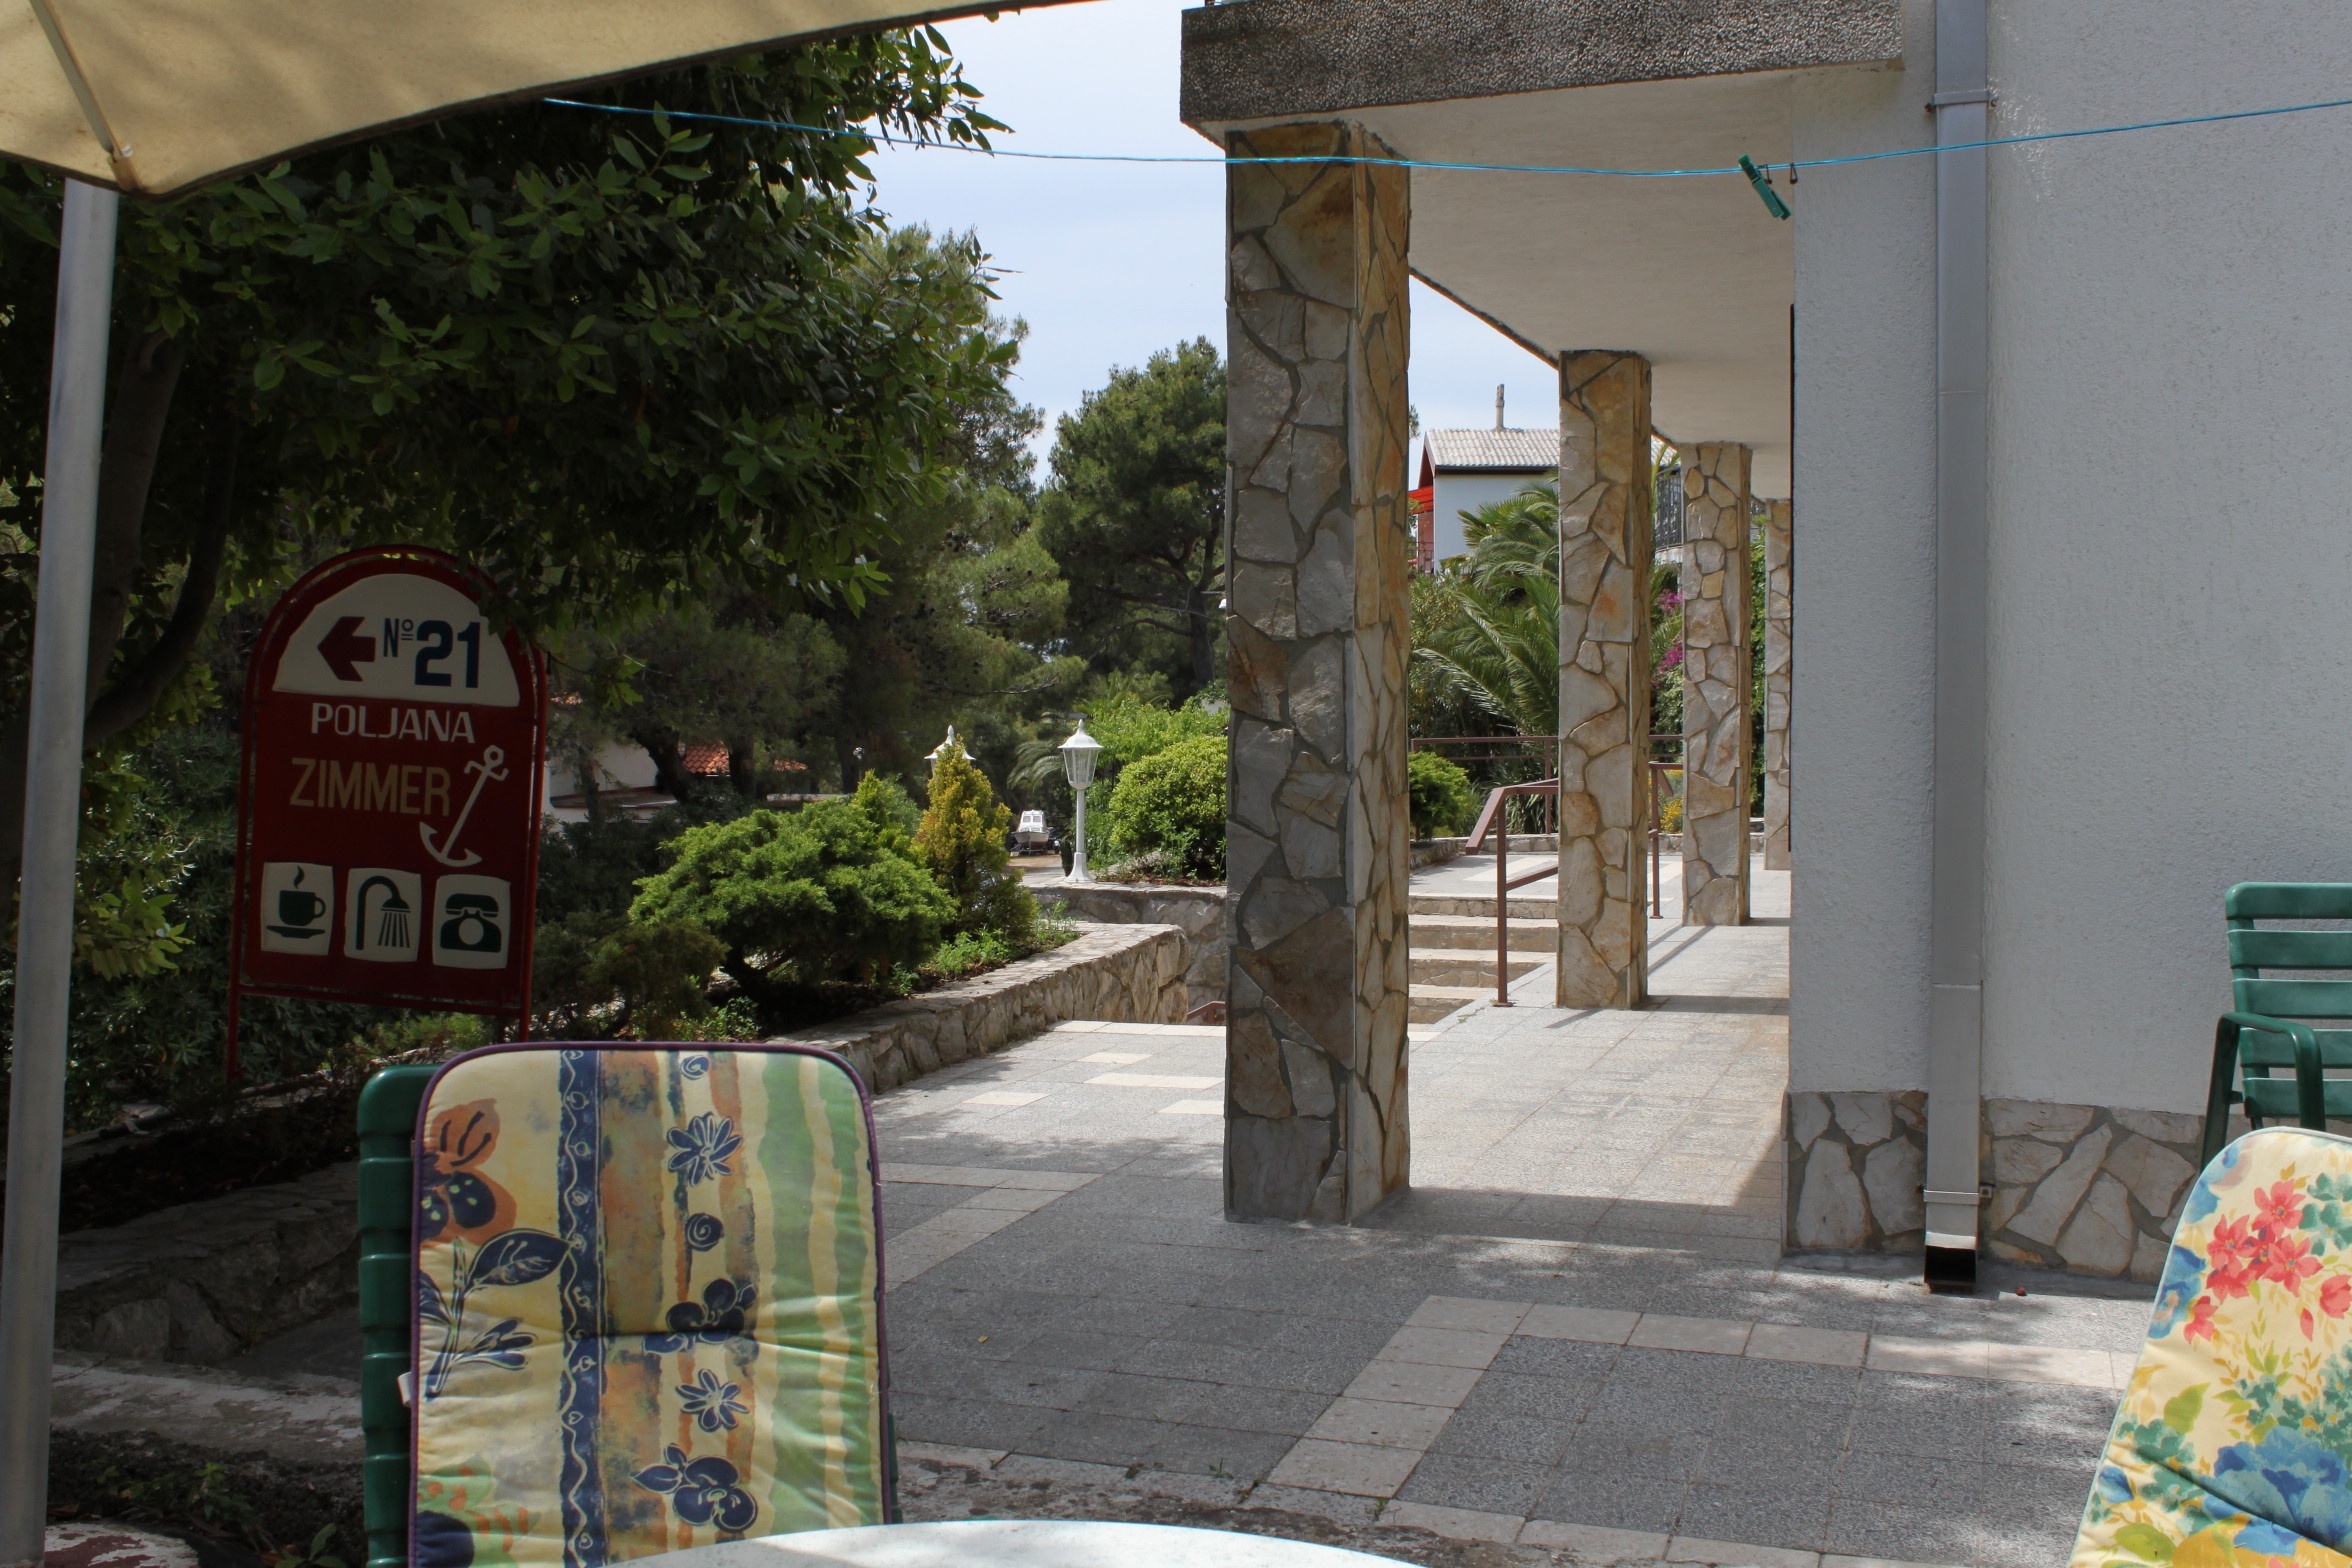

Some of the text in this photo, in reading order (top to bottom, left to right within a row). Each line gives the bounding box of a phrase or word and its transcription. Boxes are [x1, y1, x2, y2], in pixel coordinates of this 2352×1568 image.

[414, 619, 480, 688] 21
[311, 702, 475, 744] POLJANA
[290, 757, 451, 816] ZIMMER
